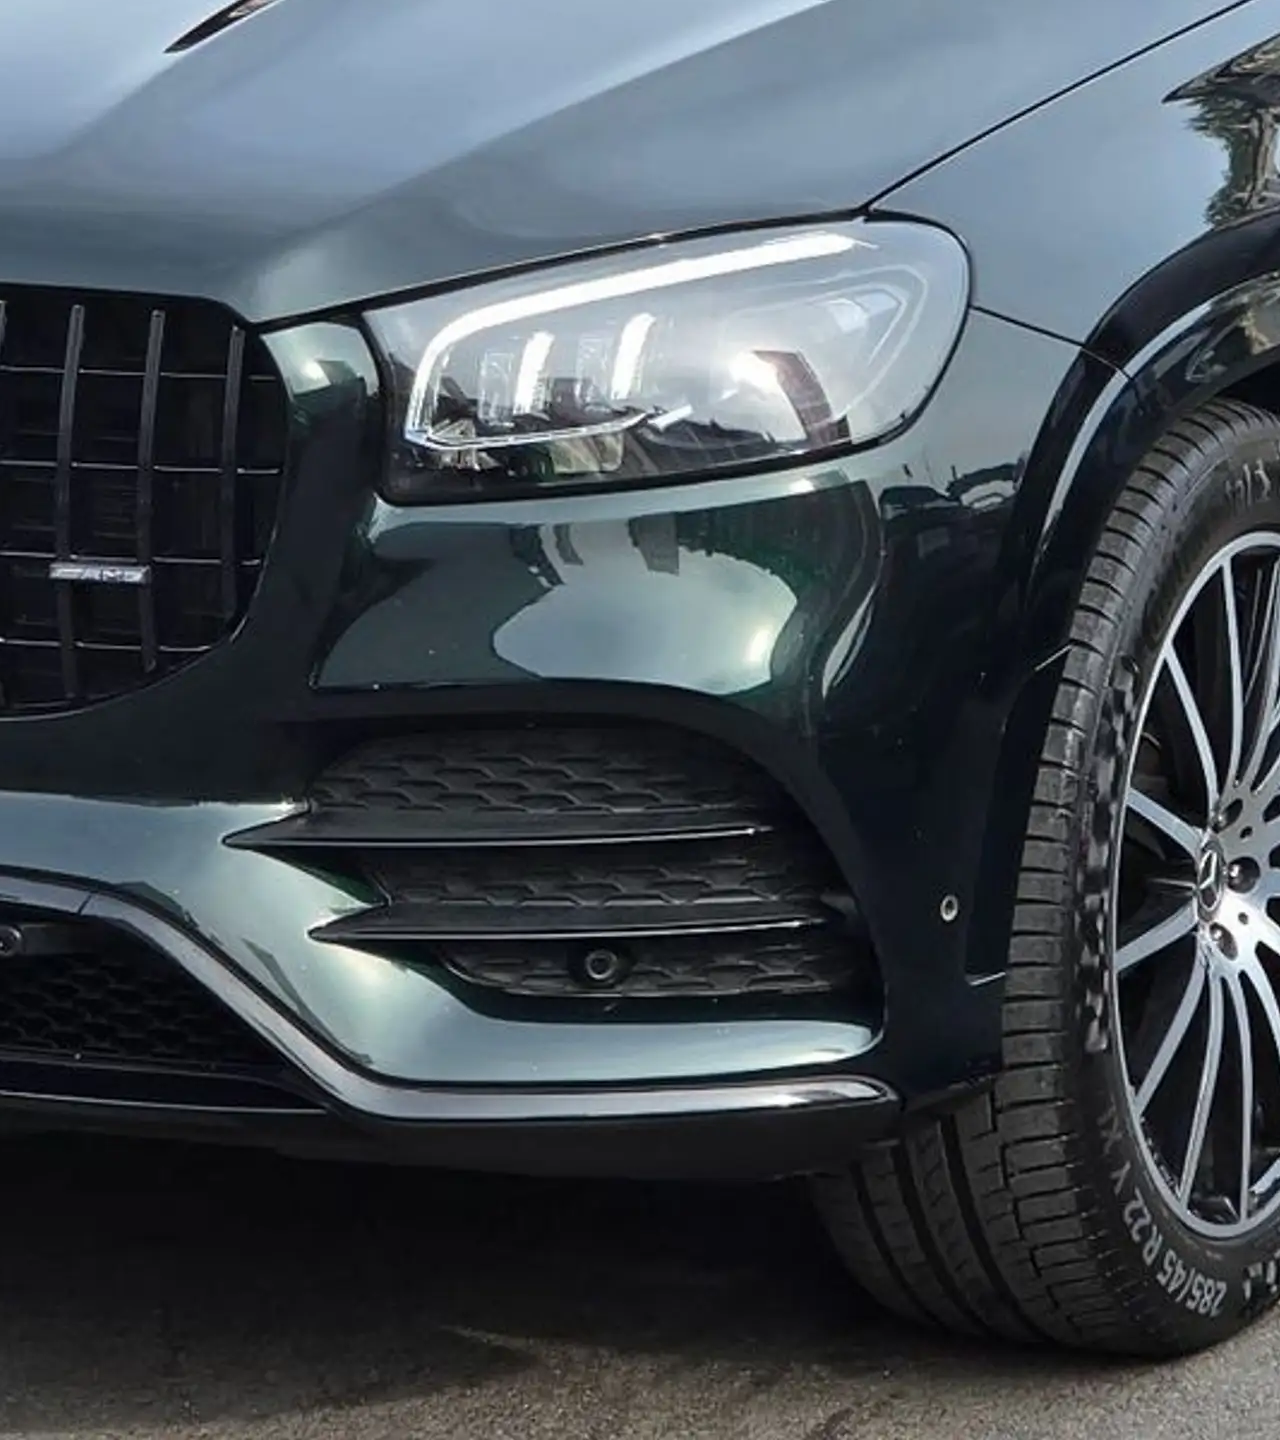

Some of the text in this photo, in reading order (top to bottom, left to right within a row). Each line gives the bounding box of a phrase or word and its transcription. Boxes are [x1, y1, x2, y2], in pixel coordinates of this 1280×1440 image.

[1123, 1185, 1152, 1242] 22
[1142, 1226, 1163, 1265] R
[1157, 1249, 1227, 1317] 285/45
